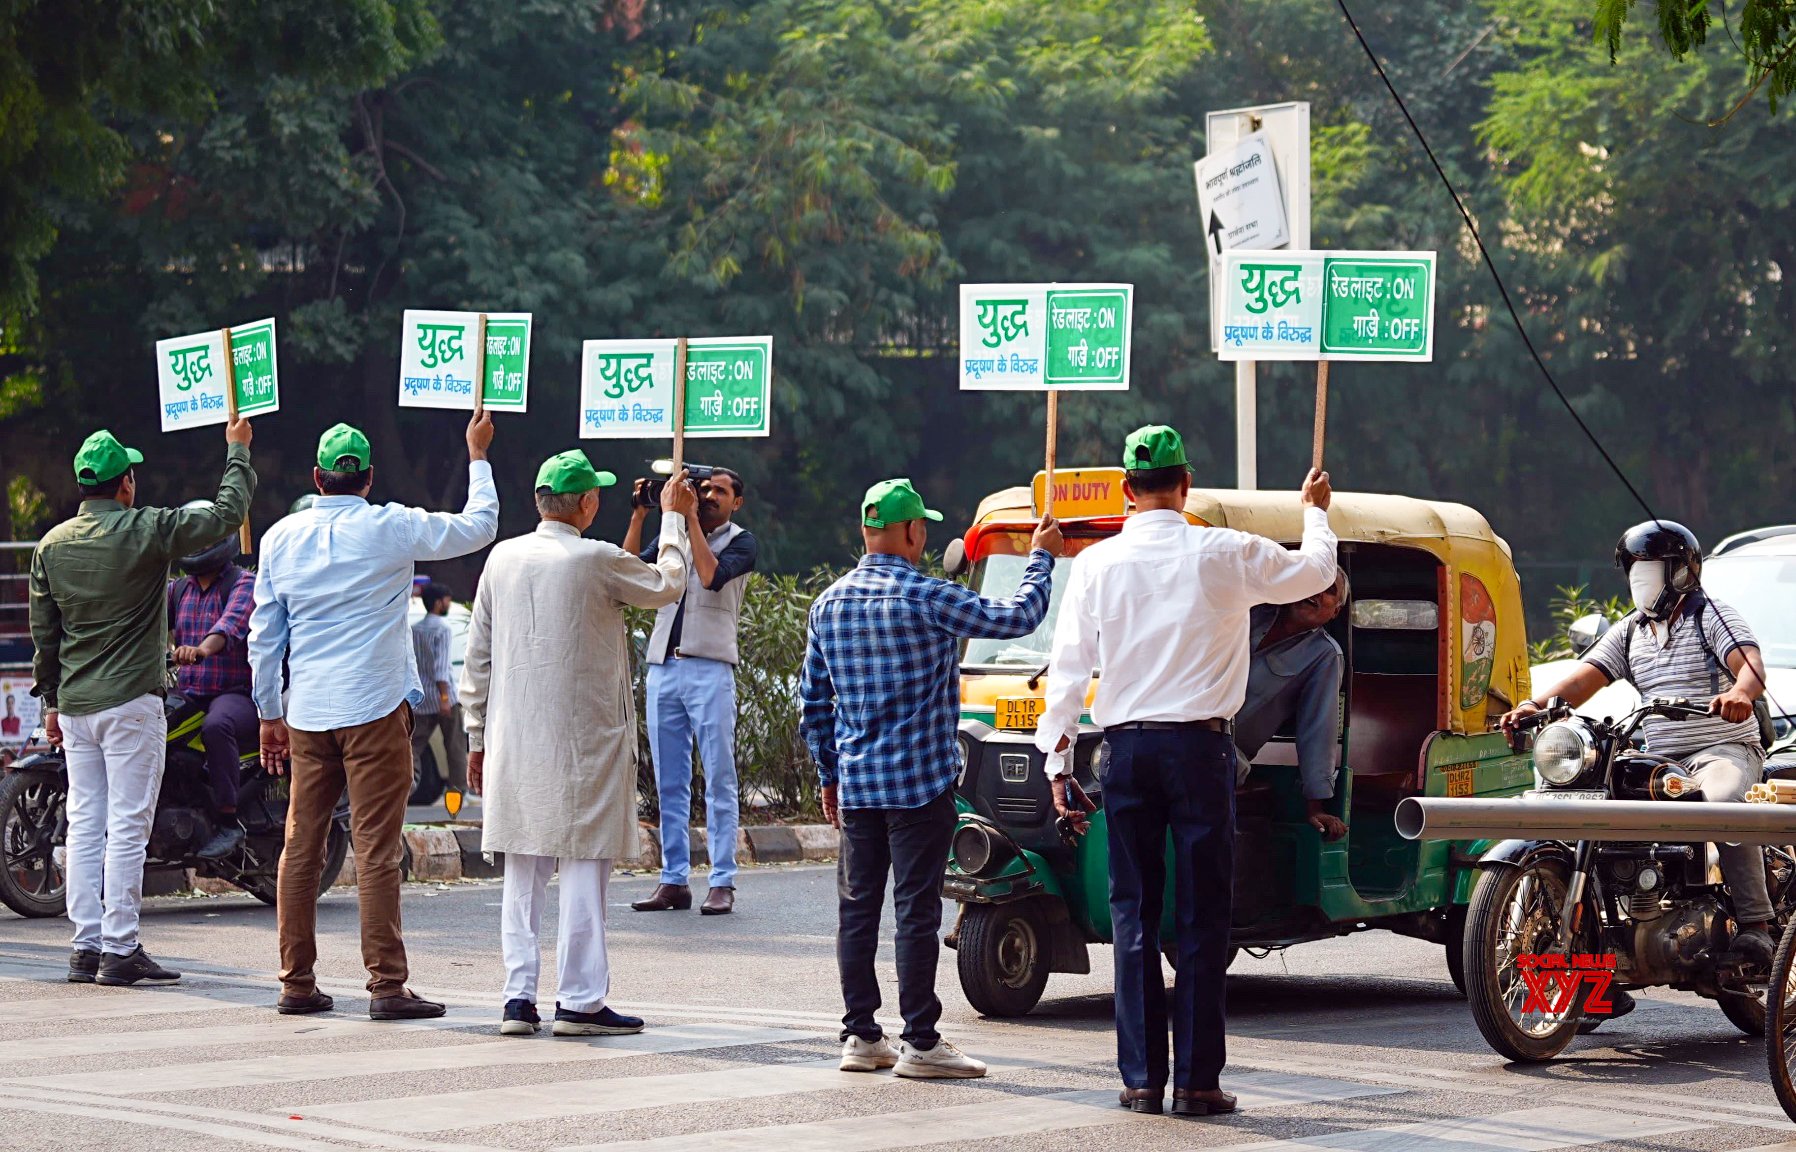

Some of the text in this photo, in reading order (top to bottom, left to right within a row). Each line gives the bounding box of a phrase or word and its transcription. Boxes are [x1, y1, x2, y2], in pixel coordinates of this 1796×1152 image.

[1240, 263, 1303, 314] युद्ध
[975, 299, 1029, 348] युद्ध
[1224, 320, 1312, 346] प्रदूषण के विरुद्ध
[1353, 308, 1380, 344] गाड़ी
[417, 323, 465, 369] युद्ध
[1067, 338, 1089, 374] गाड़ी
[169, 344, 212, 391] युद्ध
[598, 353, 654, 399] युद्ध
[965, 353, 1039, 380] प्रदूषण के विरुद्ध
[404, 374, 472, 396] प्रदूषण के विरुद्ध
[165, 392, 224, 420] प्रदूषण के विरुद्ध
[585, 403, 664, 428] प्रदूषण के विरुद्ध
[700, 389, 724, 422] गाड़ी
[1072, 482, 1111, 501] DUTY
